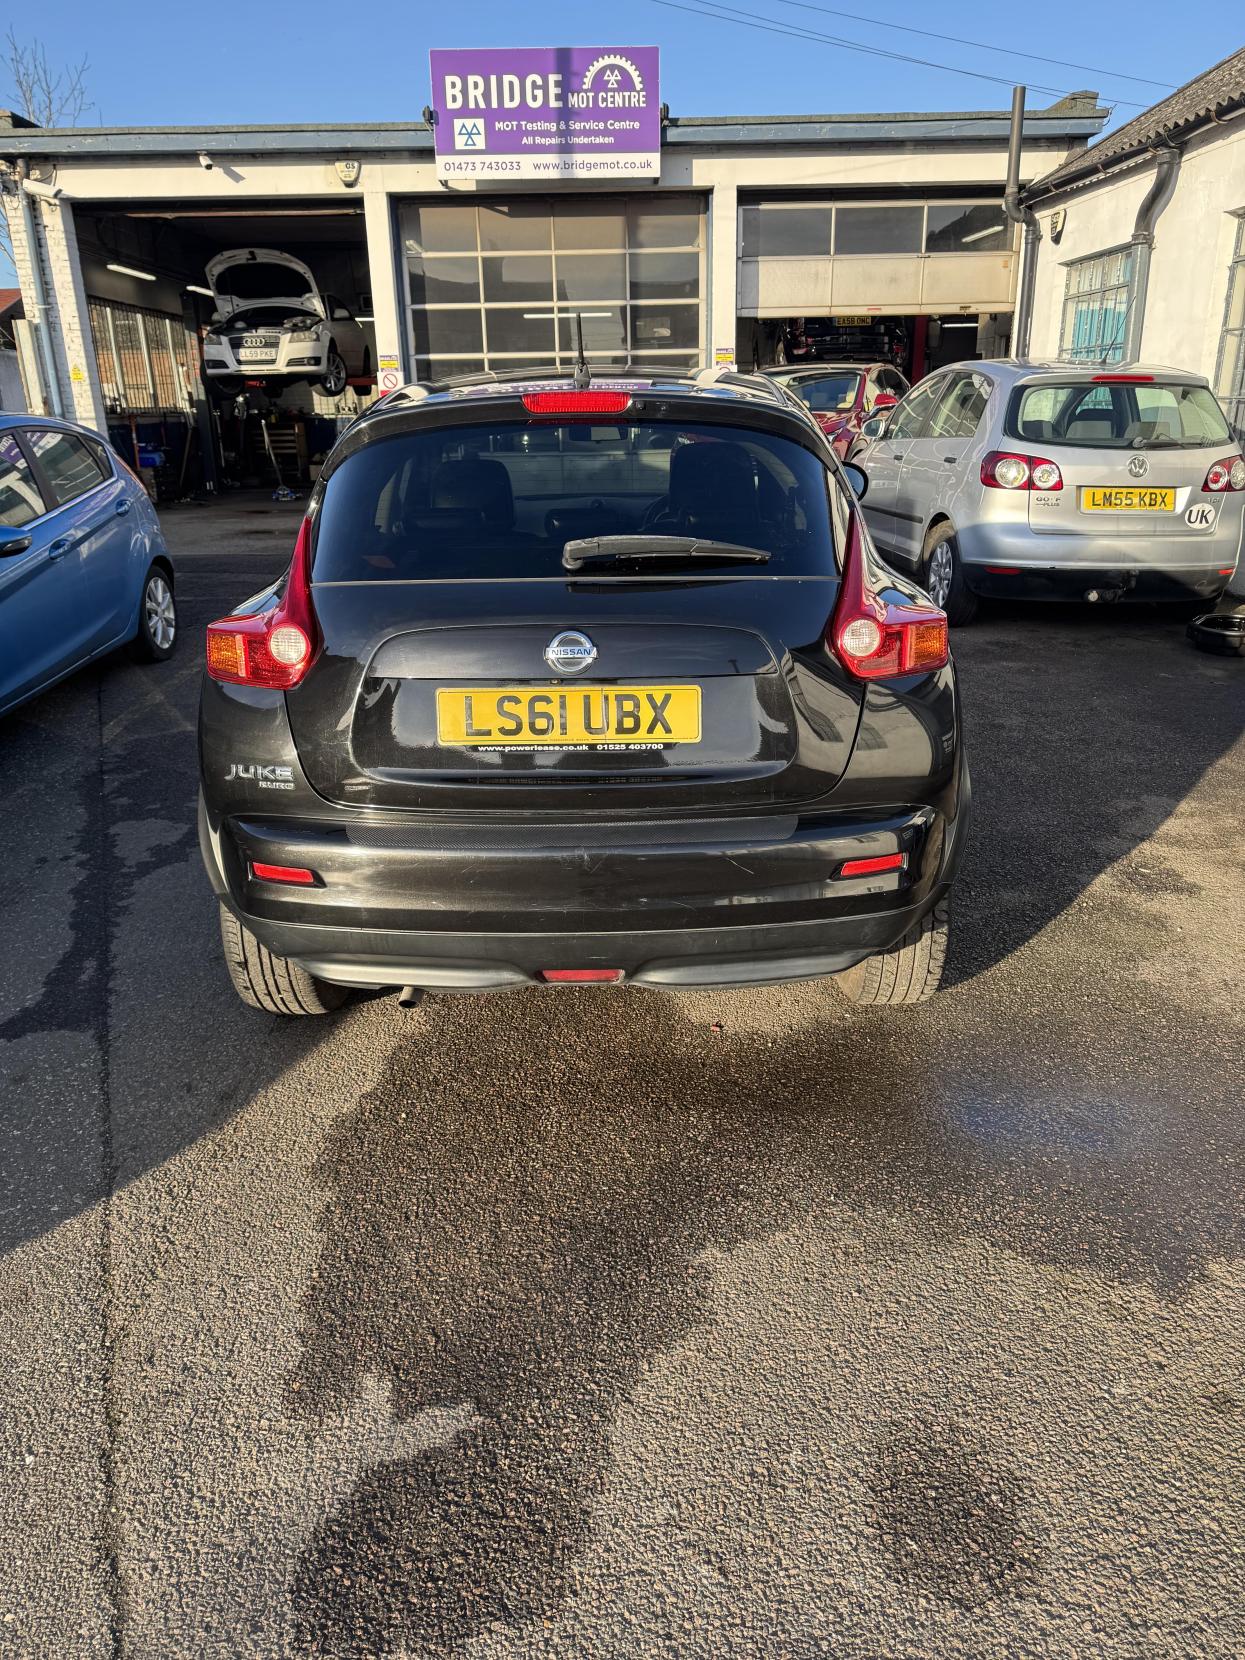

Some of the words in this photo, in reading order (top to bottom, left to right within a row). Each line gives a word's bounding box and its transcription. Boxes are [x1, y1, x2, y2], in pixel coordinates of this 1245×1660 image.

[444, 73, 563, 110] BRIDGE
[568, 92, 595, 108] MOT
[598, 91, 646, 108] CENTRE
[495, 121, 517, 131] MOT
[519, 120, 557, 133] Testing
[559, 120, 566, 130] &
[568, 120, 605, 130] Service
[607, 119, 640, 130] Centre
[522, 136, 534, 145] All
[535, 136, 565, 146] Repairs
[567, 135, 614, 145] Undertaken
[444, 161, 477, 171] 01473
[480, 161, 521, 171] 743033
[533, 159, 652, 172] www.bridgemot.co.uk
[1091, 491, 1134, 507] LM55
[1138, 491, 1168, 508] KBX
[1187, 508, 1214, 525] UK
[551, 648, 591, 656] NISSAN
[464, 694, 568, 737] LS61
[582, 692, 673, 736] UBX
[477, 744, 589, 752] www.powerlease.co.uk
[597, 743, 626, 751] 01525
[223, 764, 294, 781] JUKE
